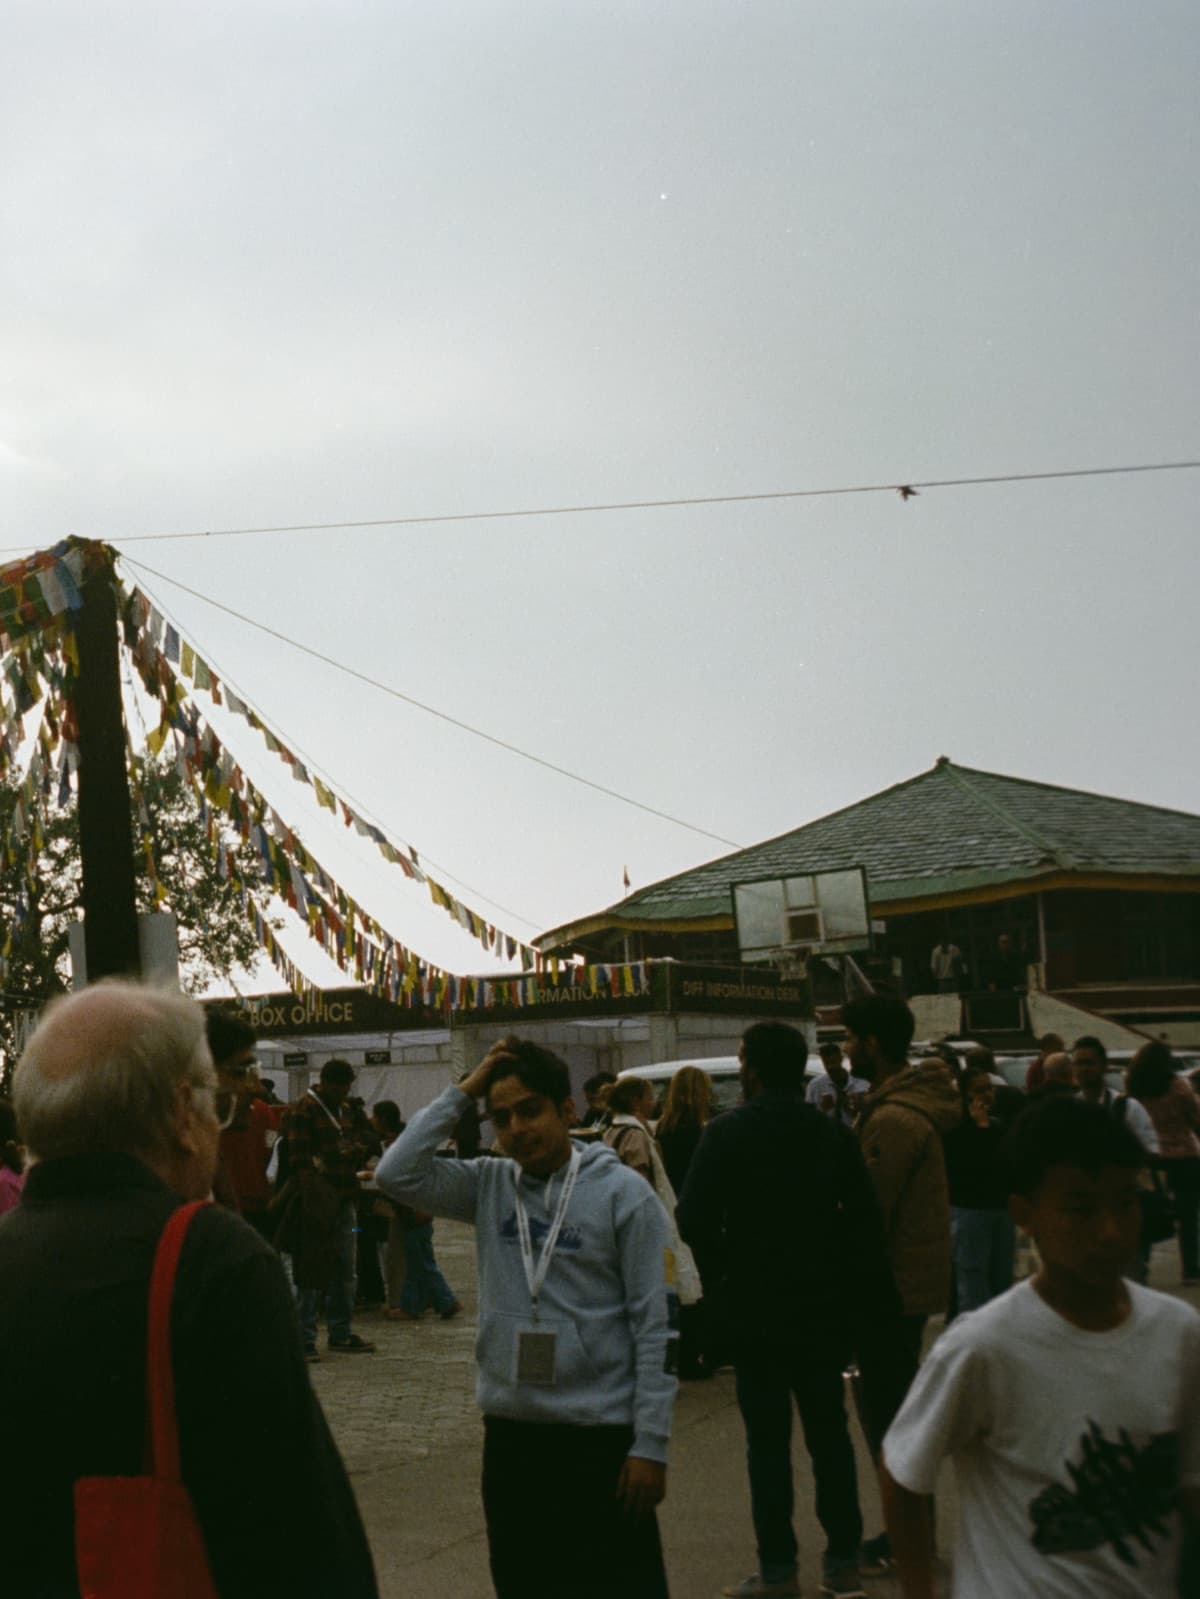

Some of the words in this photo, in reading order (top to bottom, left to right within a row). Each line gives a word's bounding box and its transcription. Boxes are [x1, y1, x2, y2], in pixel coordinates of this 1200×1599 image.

[707, 982, 776, 1000] INFORMATION
[777, 986, 800, 1001] DESK
[250, 1007, 287, 1026] BOX
